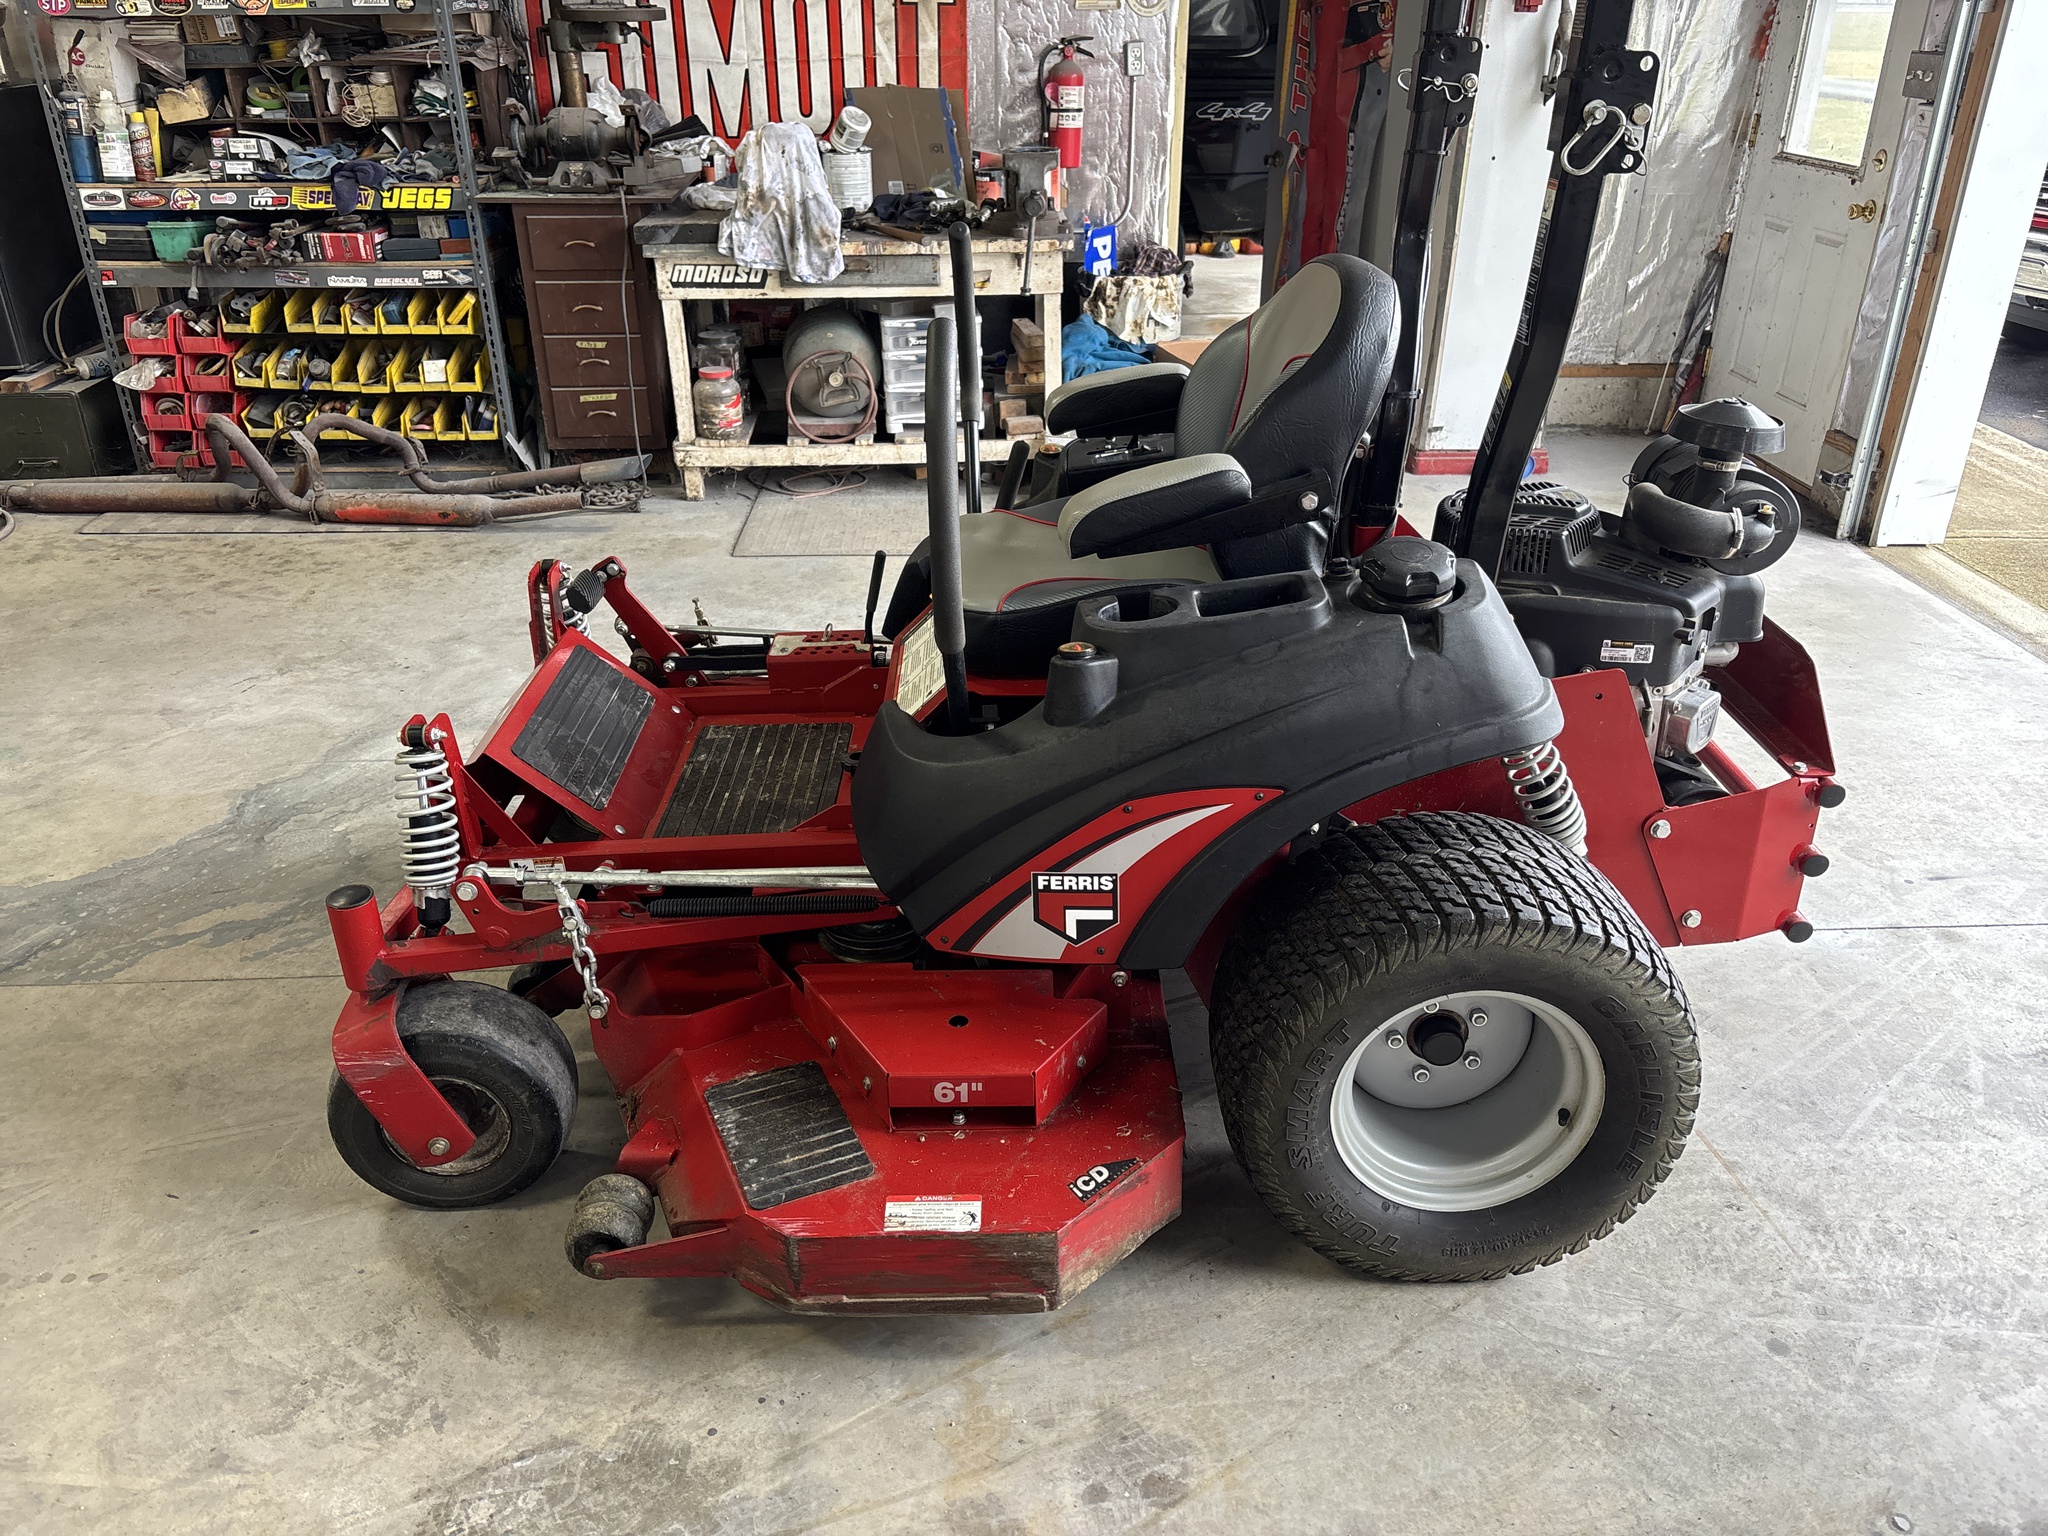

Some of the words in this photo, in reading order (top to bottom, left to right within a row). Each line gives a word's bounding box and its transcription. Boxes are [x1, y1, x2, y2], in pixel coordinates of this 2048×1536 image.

[1291, 10, 1312, 114] THE
[1196, 102, 1272, 121] 4x4
[308, 190, 370, 205] SPEAY
[382, 188, 451, 209] JEGS
[671, 265, 764, 283] MOROSO
[1037, 875, 1114, 890] FERRIS
[933, 1082, 983, 1103] 61"
[1286, 1018, 1351, 1169] SMART
[1591, 995, 1665, 1181] CARLISLE
[1304, 1190, 1401, 1257] TURF
